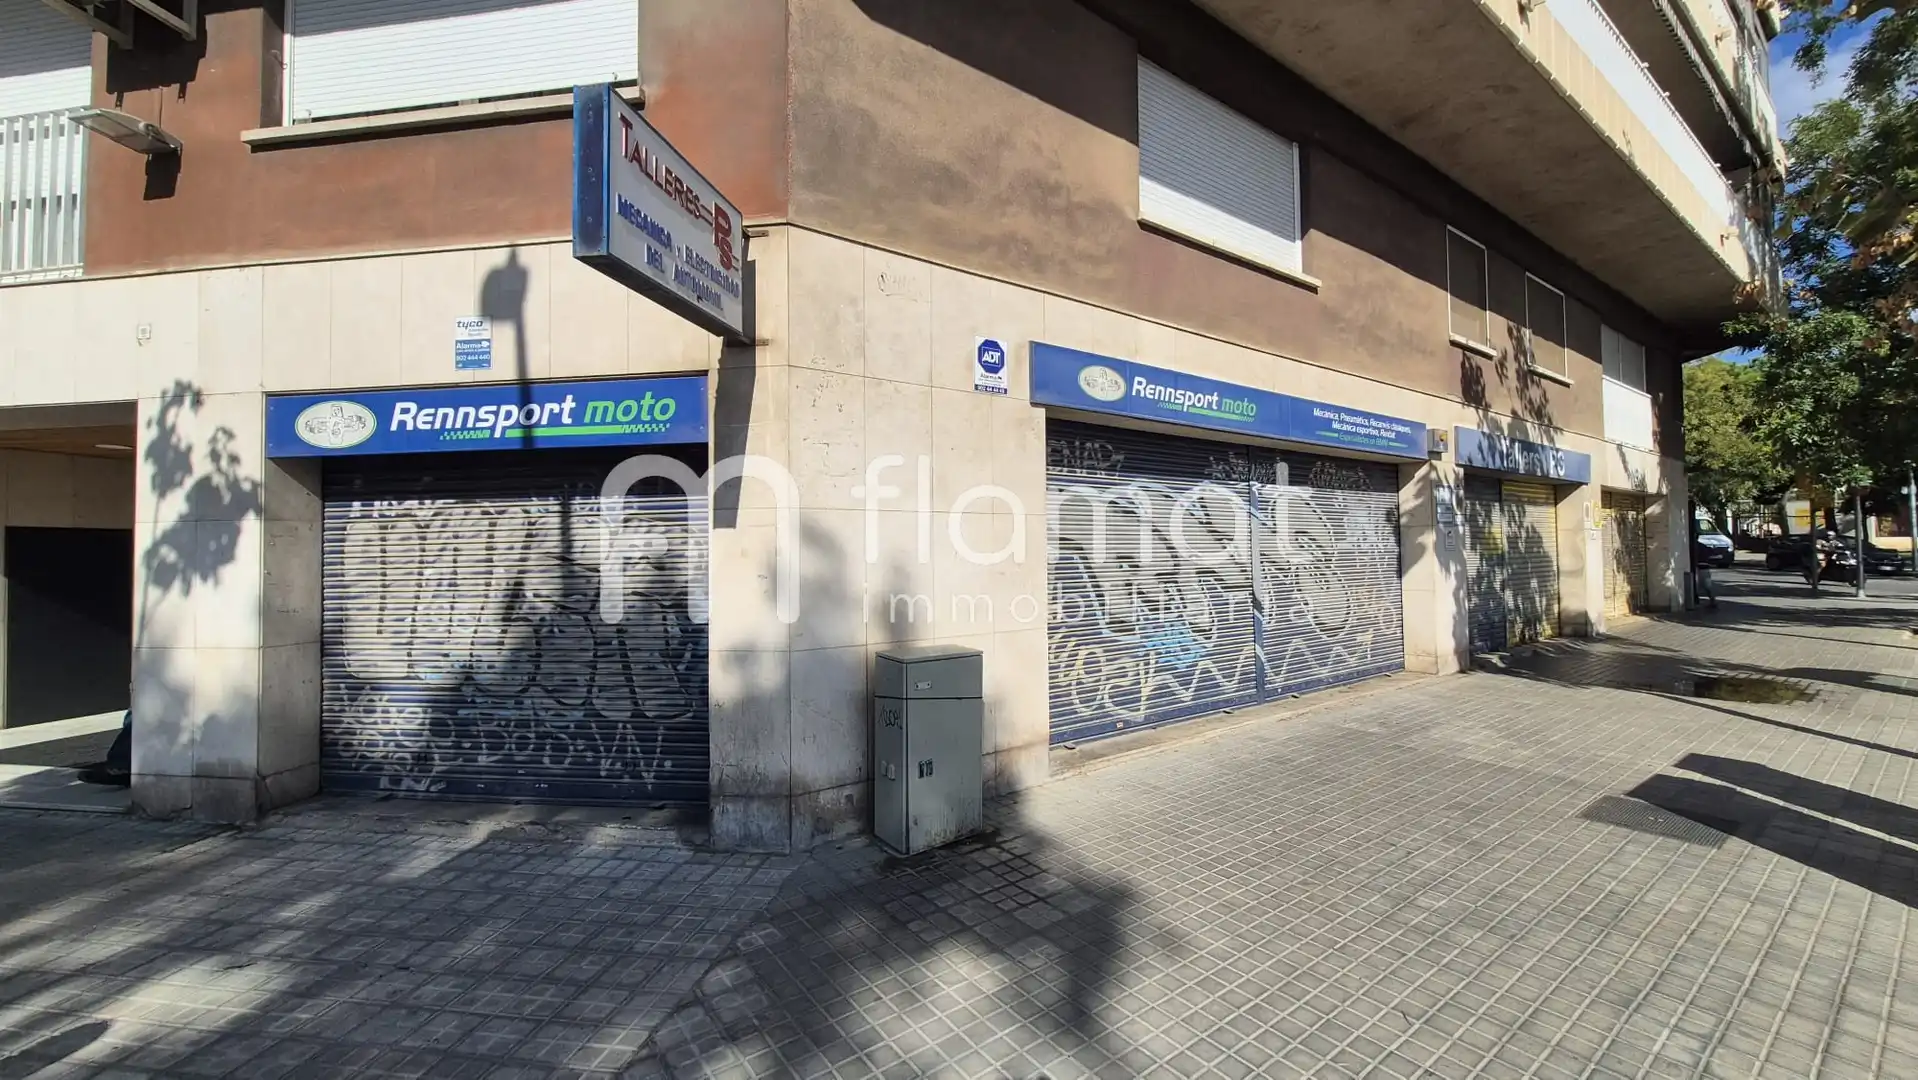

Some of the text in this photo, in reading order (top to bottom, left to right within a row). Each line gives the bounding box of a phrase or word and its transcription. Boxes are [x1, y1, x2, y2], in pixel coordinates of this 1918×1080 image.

[618, 112, 701, 220] TALLERES
[456, 320, 484, 330] tyco
[982, 350, 1000, 364] ADT
[390, 391, 676, 438] Rennsport moto
[1132, 376, 1257, 417] Rennsport moto
